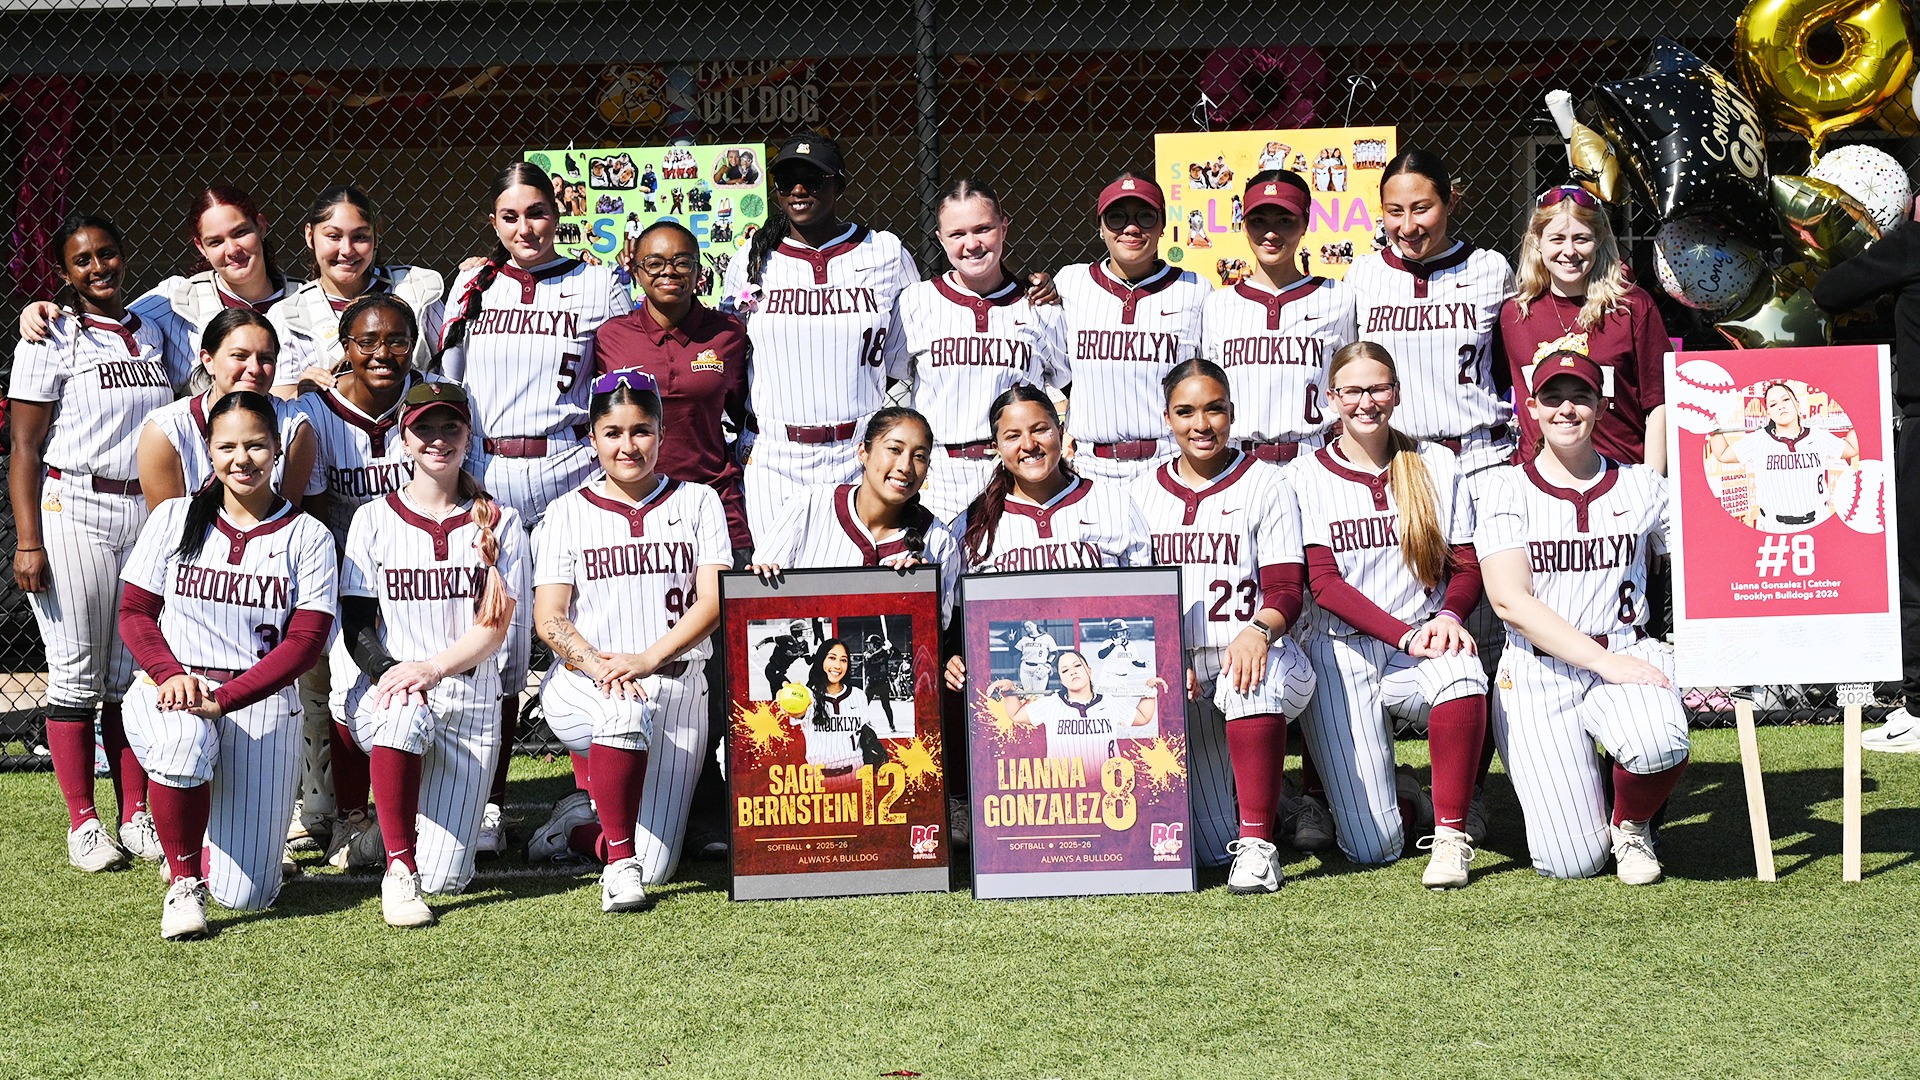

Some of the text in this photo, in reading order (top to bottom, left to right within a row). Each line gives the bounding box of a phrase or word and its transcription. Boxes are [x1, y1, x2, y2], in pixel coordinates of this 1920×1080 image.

[697, 84, 820, 125] ULLDOG
[766, 287, 879, 316] BROOKLYN
[1366, 302, 1478, 334] BROOKLYN
[471, 307, 579, 339] BROOKLYN
[862, 327, 887, 368] 18
[930, 336, 1032, 373] BROOKLYN
[1076, 330, 1179, 364] BROOKLYN
[1223, 336, 1324, 369] BROOKLYN
[556, 352, 581, 394] 5
[1458, 344, 1484, 386] 21
[1304, 383, 1323, 425] 0
[1766, 452, 1821, 470] BROOKLYN
[328, 461, 415, 497] BROOKLY
[1151, 533, 1240, 565] ROOKLYN
[1329, 514, 1400, 553] BROOK
[583, 541, 694, 581] BROOKLYN
[1529, 533, 1638, 573] BROOKLYN
[1755, 534, 1816, 577] #8
[174, 564, 290, 610] BROOKLYN
[1208, 579, 1258, 622] 23
[1617, 580, 1637, 624] 6
[1730, 582, 1760, 591] Lianna
[1761, 580, 1802, 590] Gonzalez
[1807, 579, 1842, 588] Catcher
[1733, 589, 1839, 602] Brooklyn Bulldogs 2026
[254, 623, 280, 658] 3
[1838, 691, 1874, 705] 2026
[1057, 718, 1113, 735] BROOKLYN
[769, 763, 826, 796] SAGE
[997, 755, 1086, 791] LIANNA
[738, 792, 859, 828] BERNSTEIN
[855, 762, 908, 827] 12
[984, 791, 1102, 828] GONZALEZ
[1101, 757, 1137, 832] 8
[767, 841, 848, 852] SOFTBALL 2025-26
[911, 825, 939, 849] BC
[1009, 841, 1092, 851] SOFTBALL 2025-26
[1150, 822, 1184, 848] BC
[798, 856, 831, 864] ALWAYS
[840, 853, 879, 863] BULLDOG
[1041, 853, 1123, 864] ALWAYS A BULLDOG
